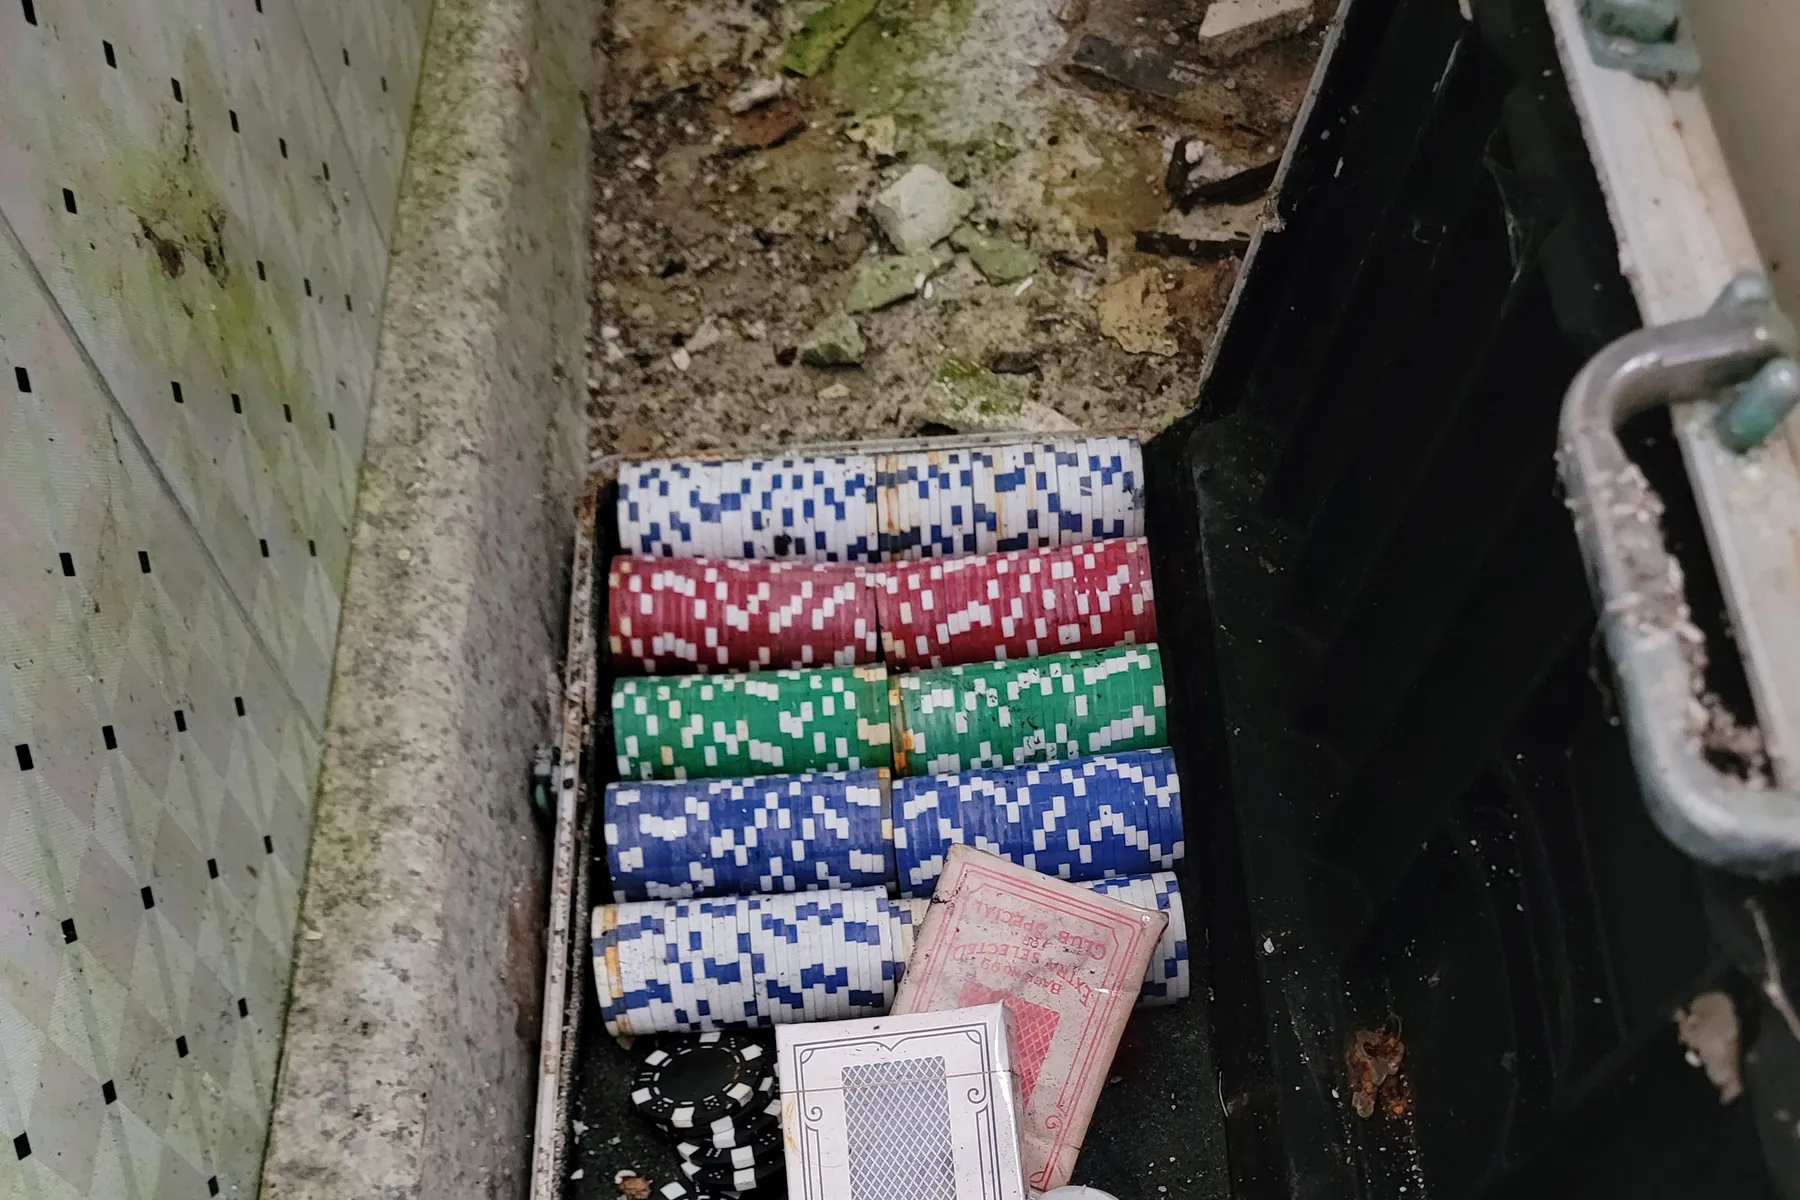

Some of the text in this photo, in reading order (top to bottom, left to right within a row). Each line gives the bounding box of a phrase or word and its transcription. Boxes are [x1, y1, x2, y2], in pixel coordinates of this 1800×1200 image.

[975, 901, 1107, 960] CLUB SPECIAL
[953, 942, 1093, 1007] EXTRA SELECTED
[981, 958, 1000, 973] 99
